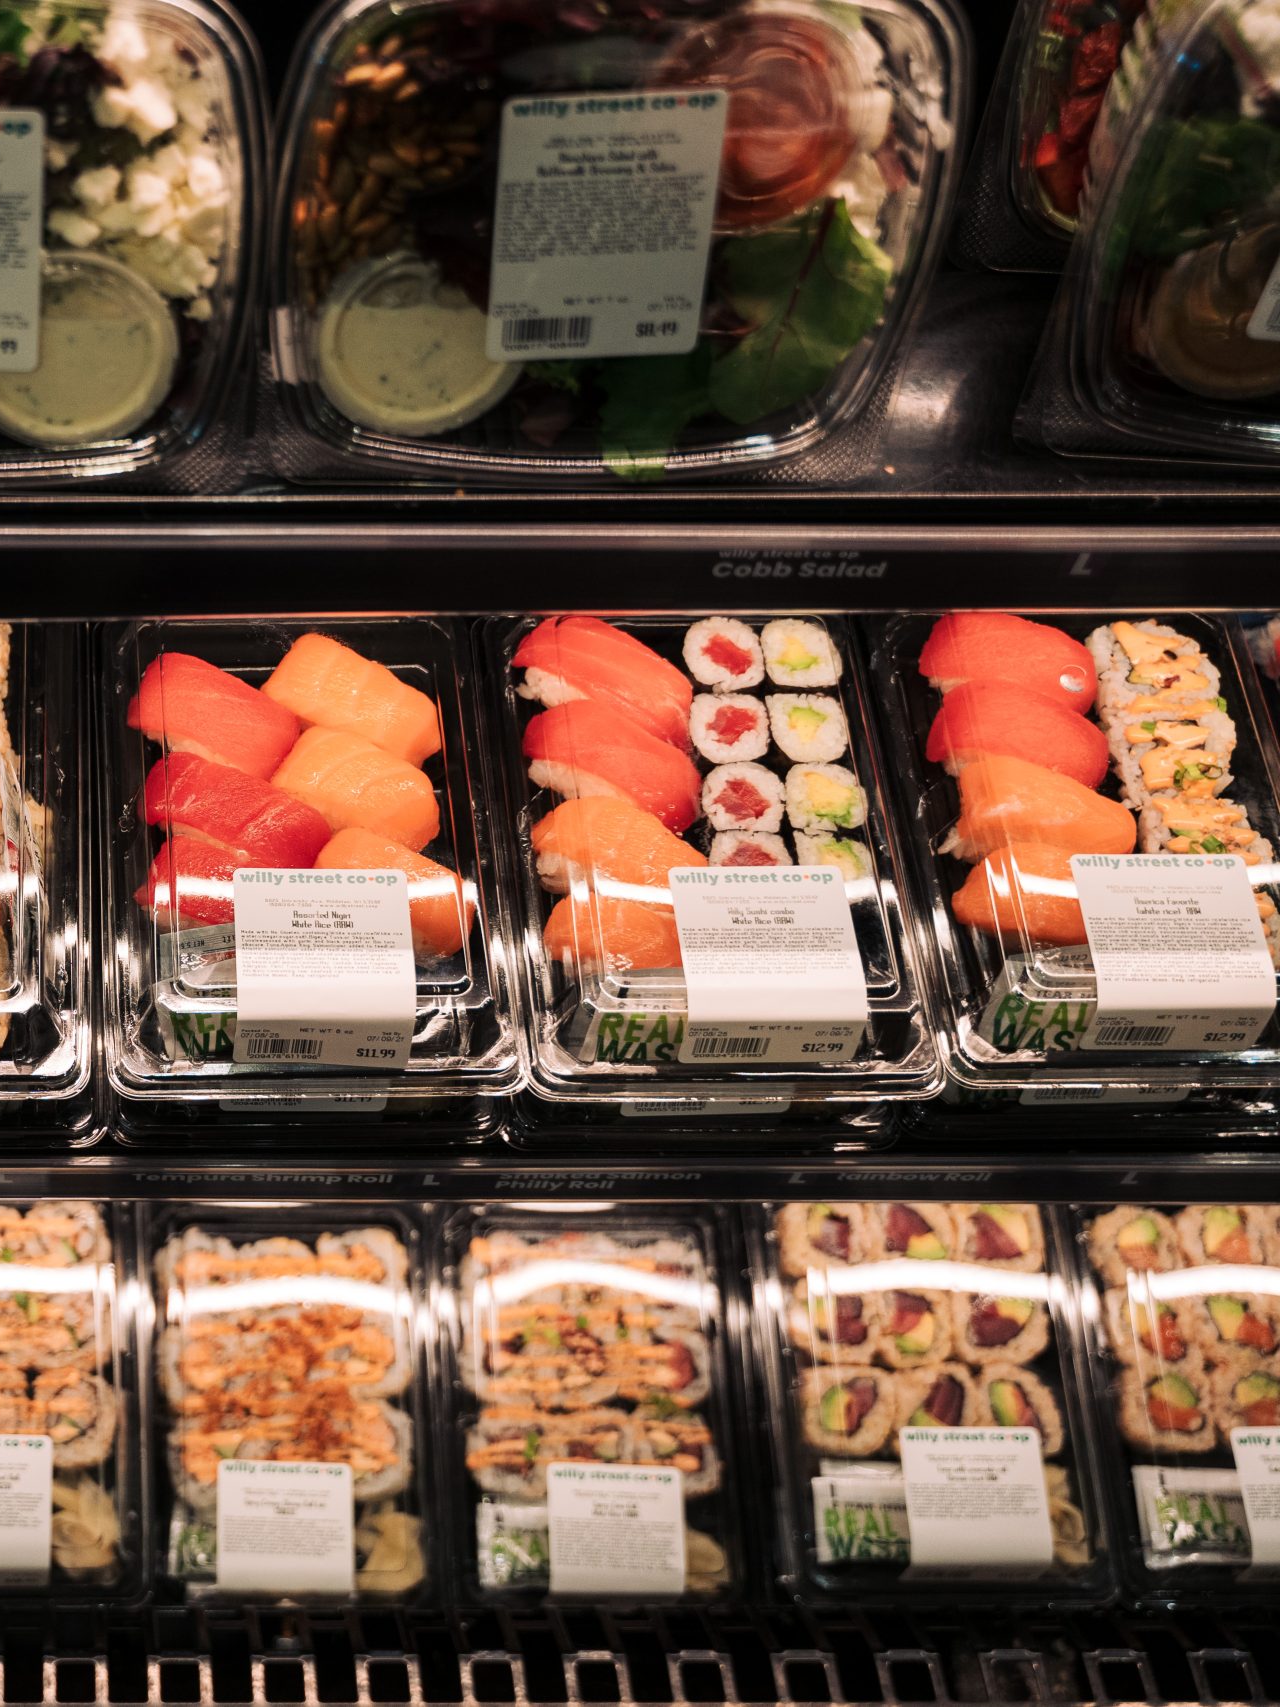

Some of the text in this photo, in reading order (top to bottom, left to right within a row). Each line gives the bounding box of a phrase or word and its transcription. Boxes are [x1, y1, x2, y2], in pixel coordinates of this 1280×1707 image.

[512, 100, 570, 119] willy
[576, 97, 645, 114] street
[712, 561, 887, 578] Cobb Salad
[1077, 856, 1120, 869] willy
[1126, 857, 1180, 868] street
[240, 872, 284, 885] willy
[289, 873, 342, 884] street
[676, 872, 719, 885] willy
[725, 873, 777, 884] street
[293, 910, 329, 919] Assorted
[770, 907, 795, 916] combo
[291, 920, 312, 929] White
[314, 921, 332, 929] Rice
[732, 917, 753, 925] White
[755, 917, 772, 925] Rice
[995, 993, 1088, 1032] REAL
[1204, 1032, 1246, 1043] $12.99
[801, 1042, 843, 1053] $12.99
[356, 1048, 396, 1059] $11.99
[133, 1173, 392, 1185] Tempura Shrimp Roll
[944, 1172, 992, 1182] Roll
[496, 1180, 615, 1190] Philly Roll
